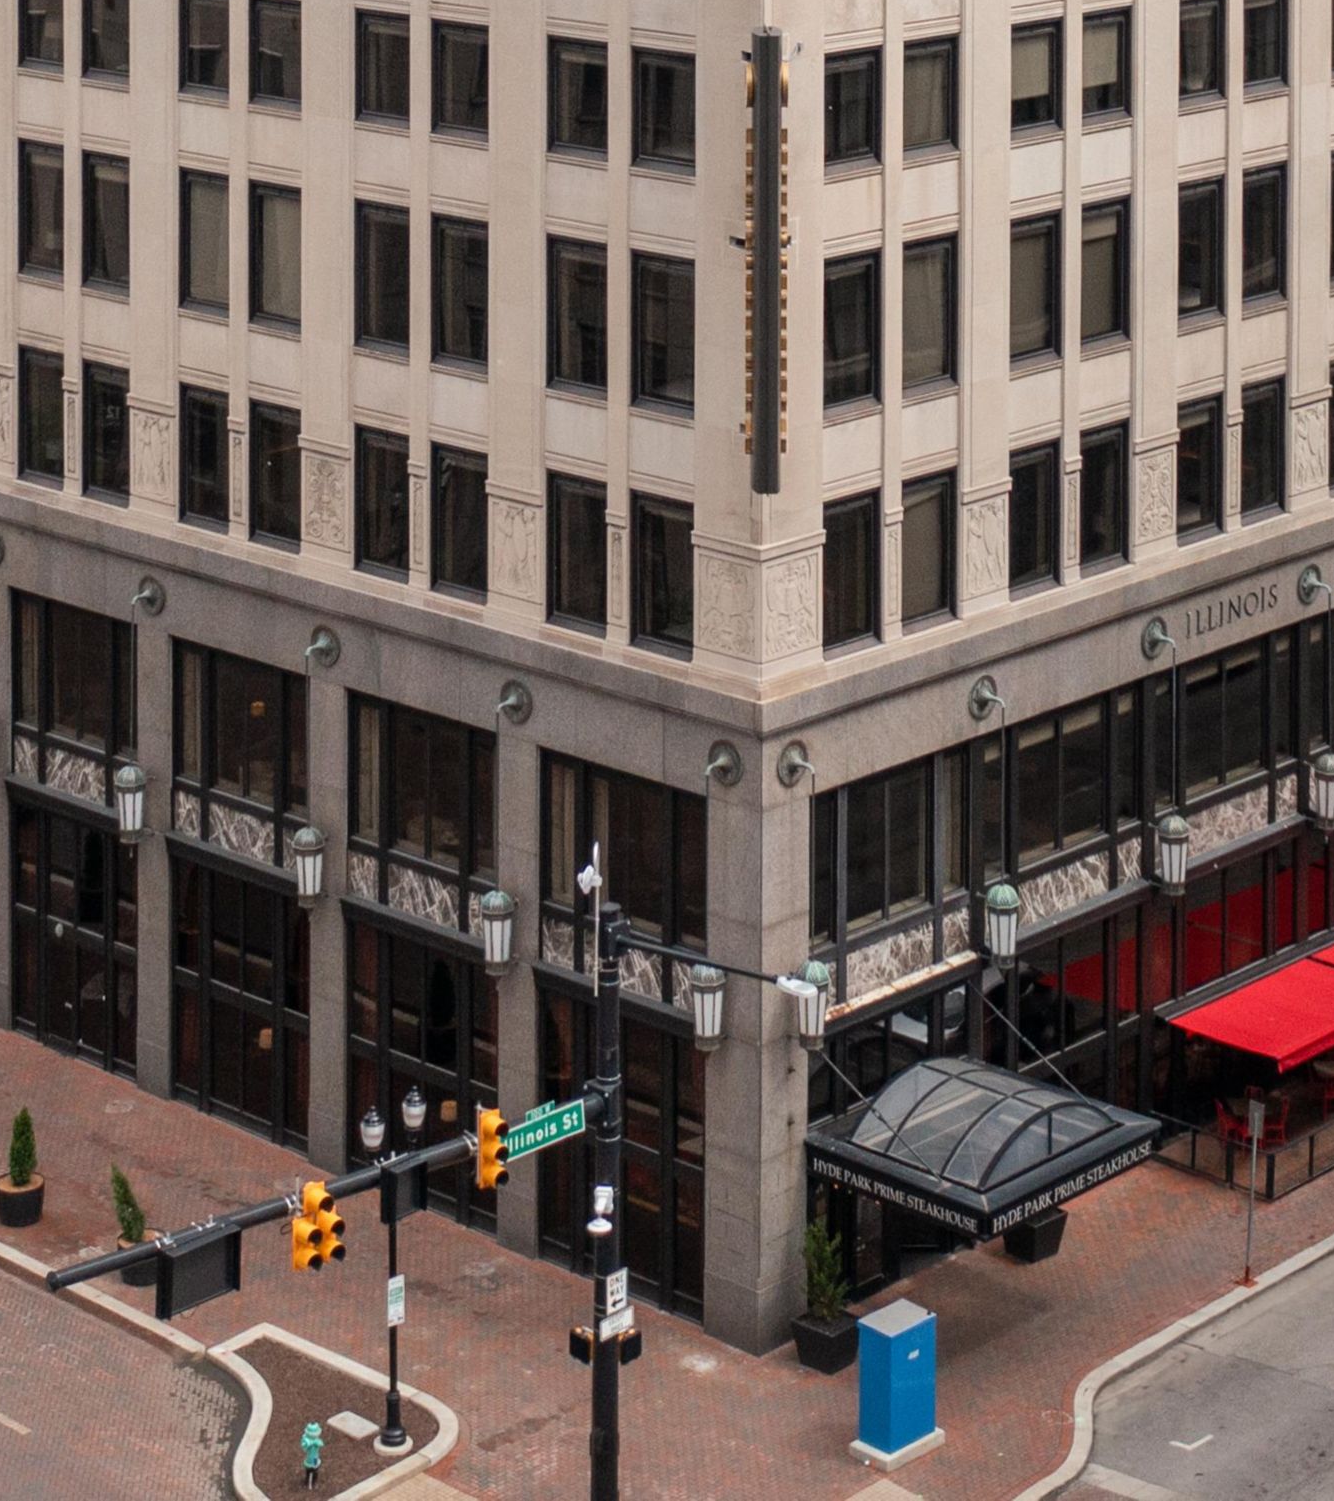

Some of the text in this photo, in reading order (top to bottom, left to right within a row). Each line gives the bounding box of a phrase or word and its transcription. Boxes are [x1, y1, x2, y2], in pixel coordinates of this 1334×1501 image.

[1185, 584, 1278, 639] ILLINOIS
[562, 1110, 578, 1130] St
[813, 1158, 977, 1233] HYDE PARK PRIME STEAKHOUSE
[993, 1141, 1152, 1234] HYDE PARK PRIME STEAKHOUSE
[610, 1275, 624, 1287] ONE
[610, 1285, 624, 1298] WAY
